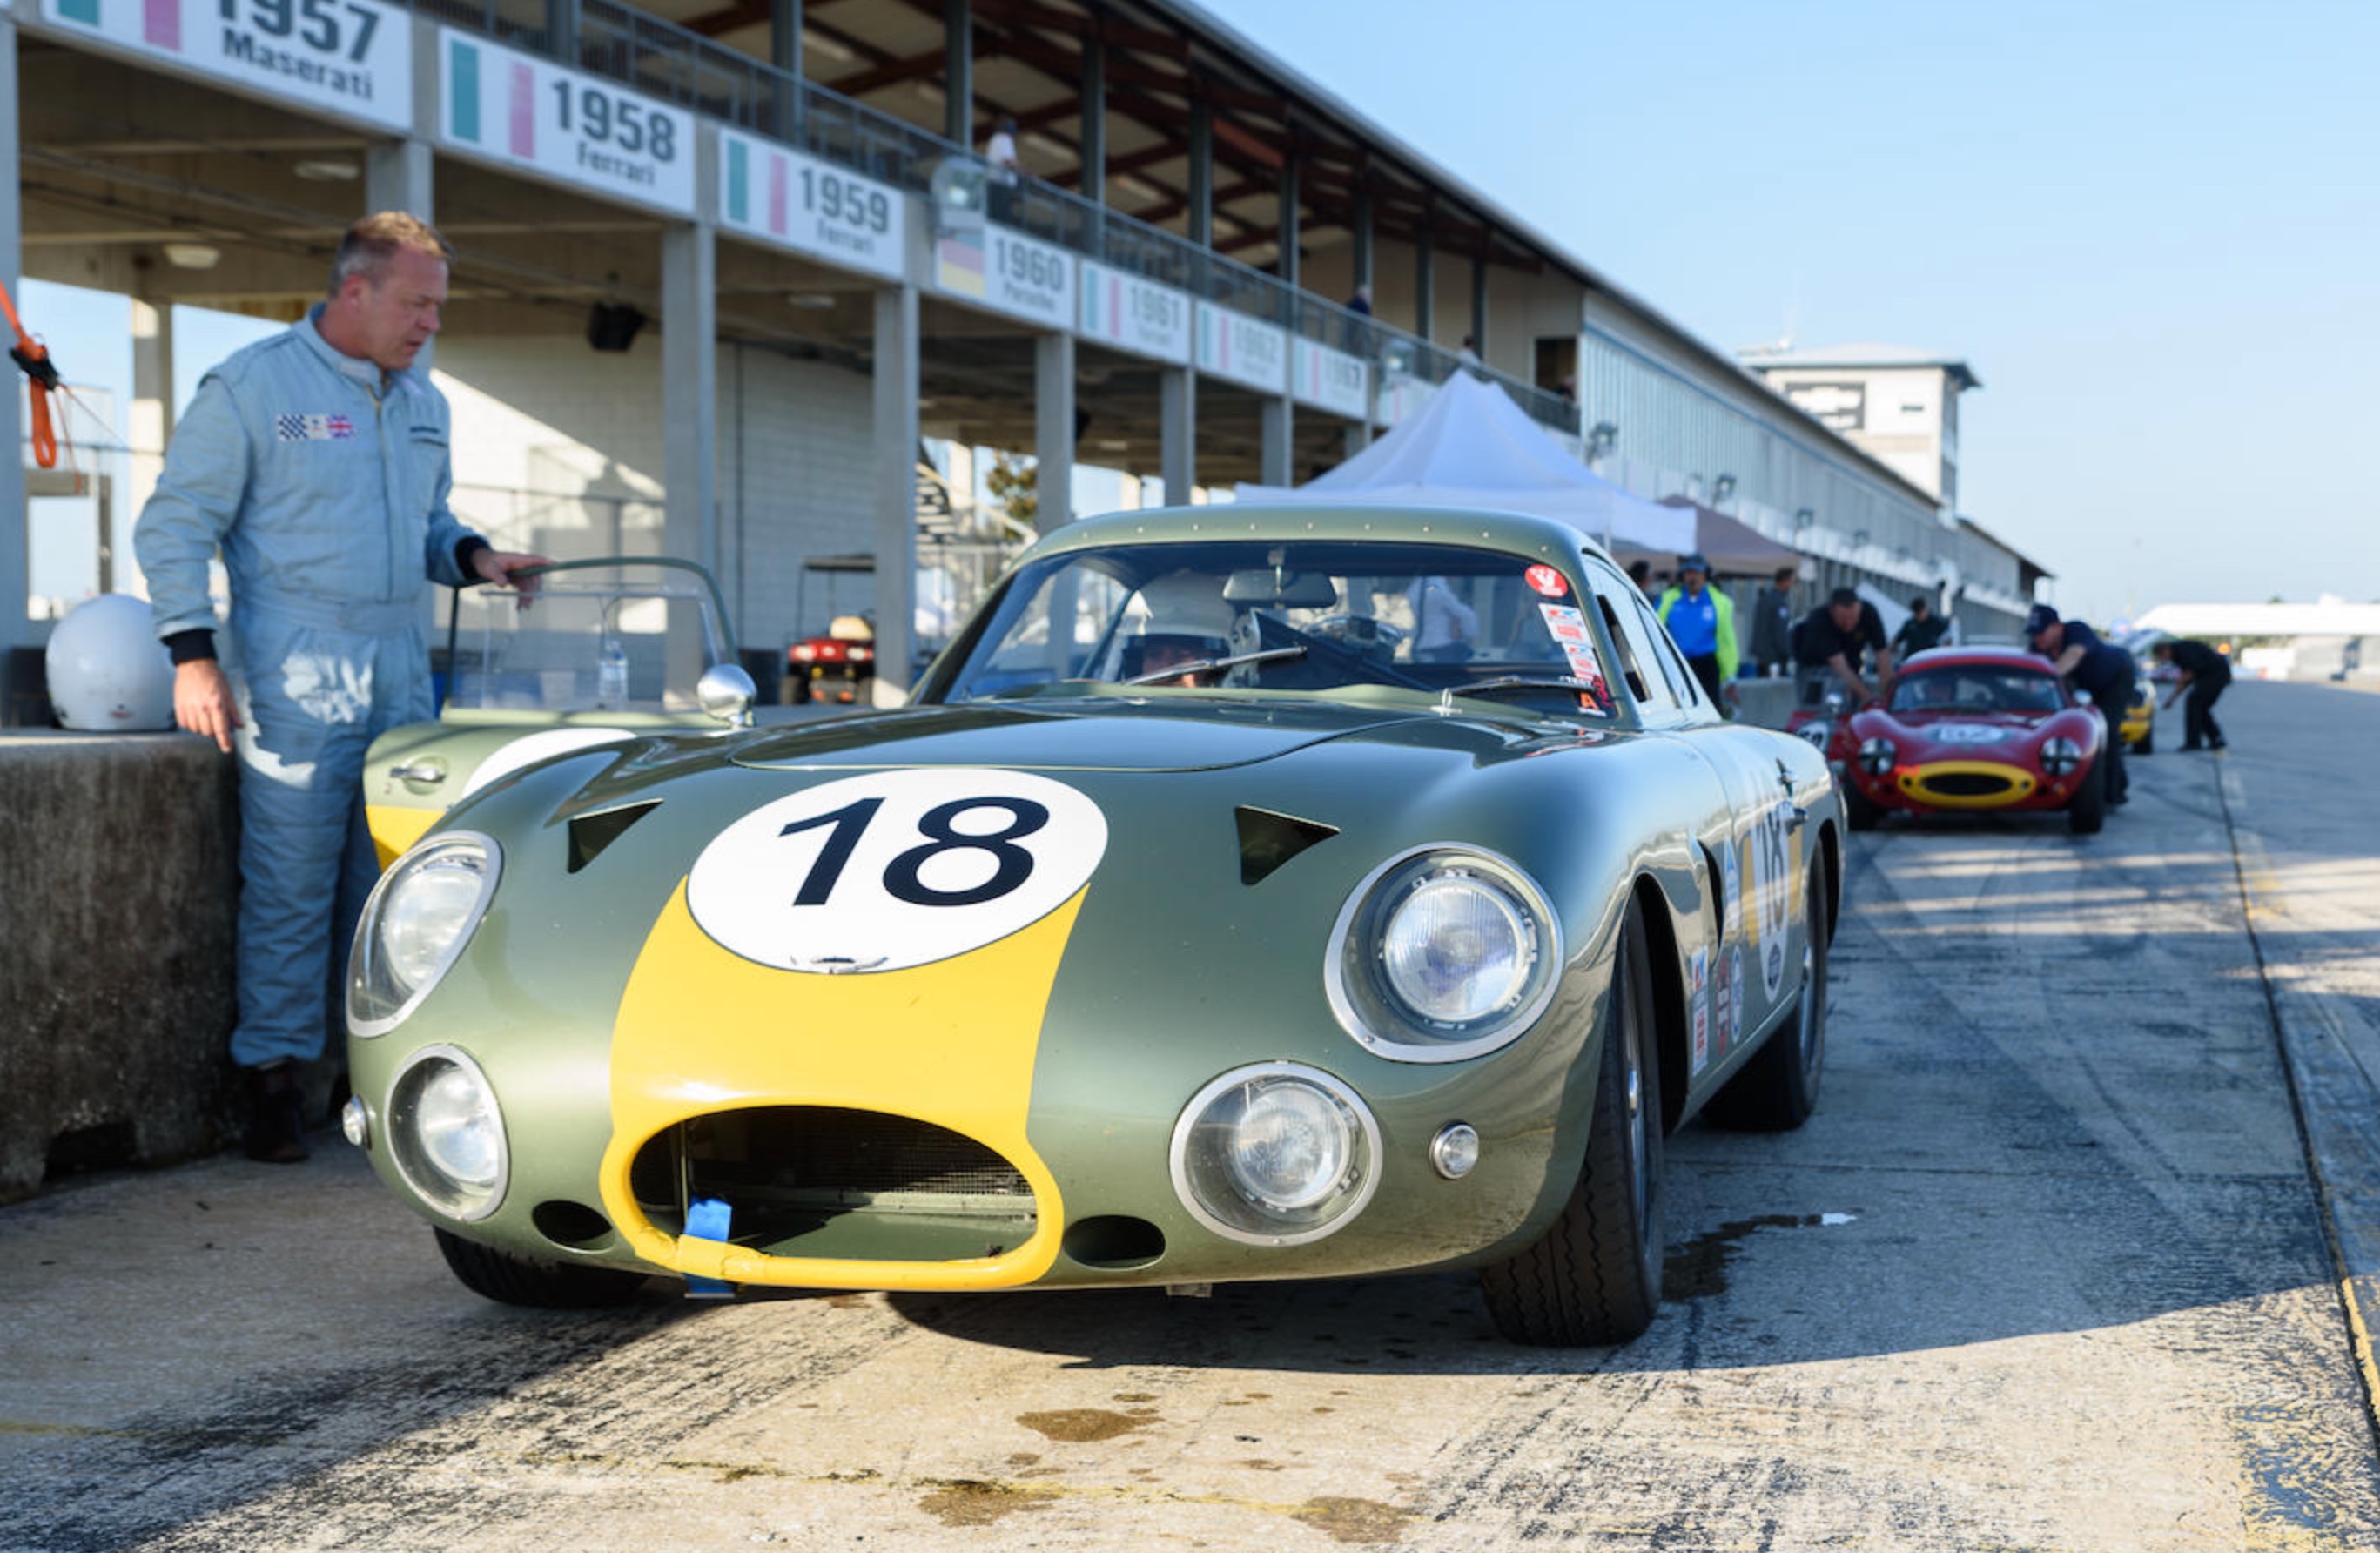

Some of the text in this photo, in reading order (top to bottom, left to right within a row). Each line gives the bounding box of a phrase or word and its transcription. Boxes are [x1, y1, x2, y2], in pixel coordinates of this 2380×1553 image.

[223, 27, 373, 100] Maserati
[552, 79, 675, 163] 1958
[799, 167, 888, 234] 1959
[995, 238, 1065, 292] 1960
[777, 797, 1050, 907] 18
[1756, 804, 1785, 937] 18
